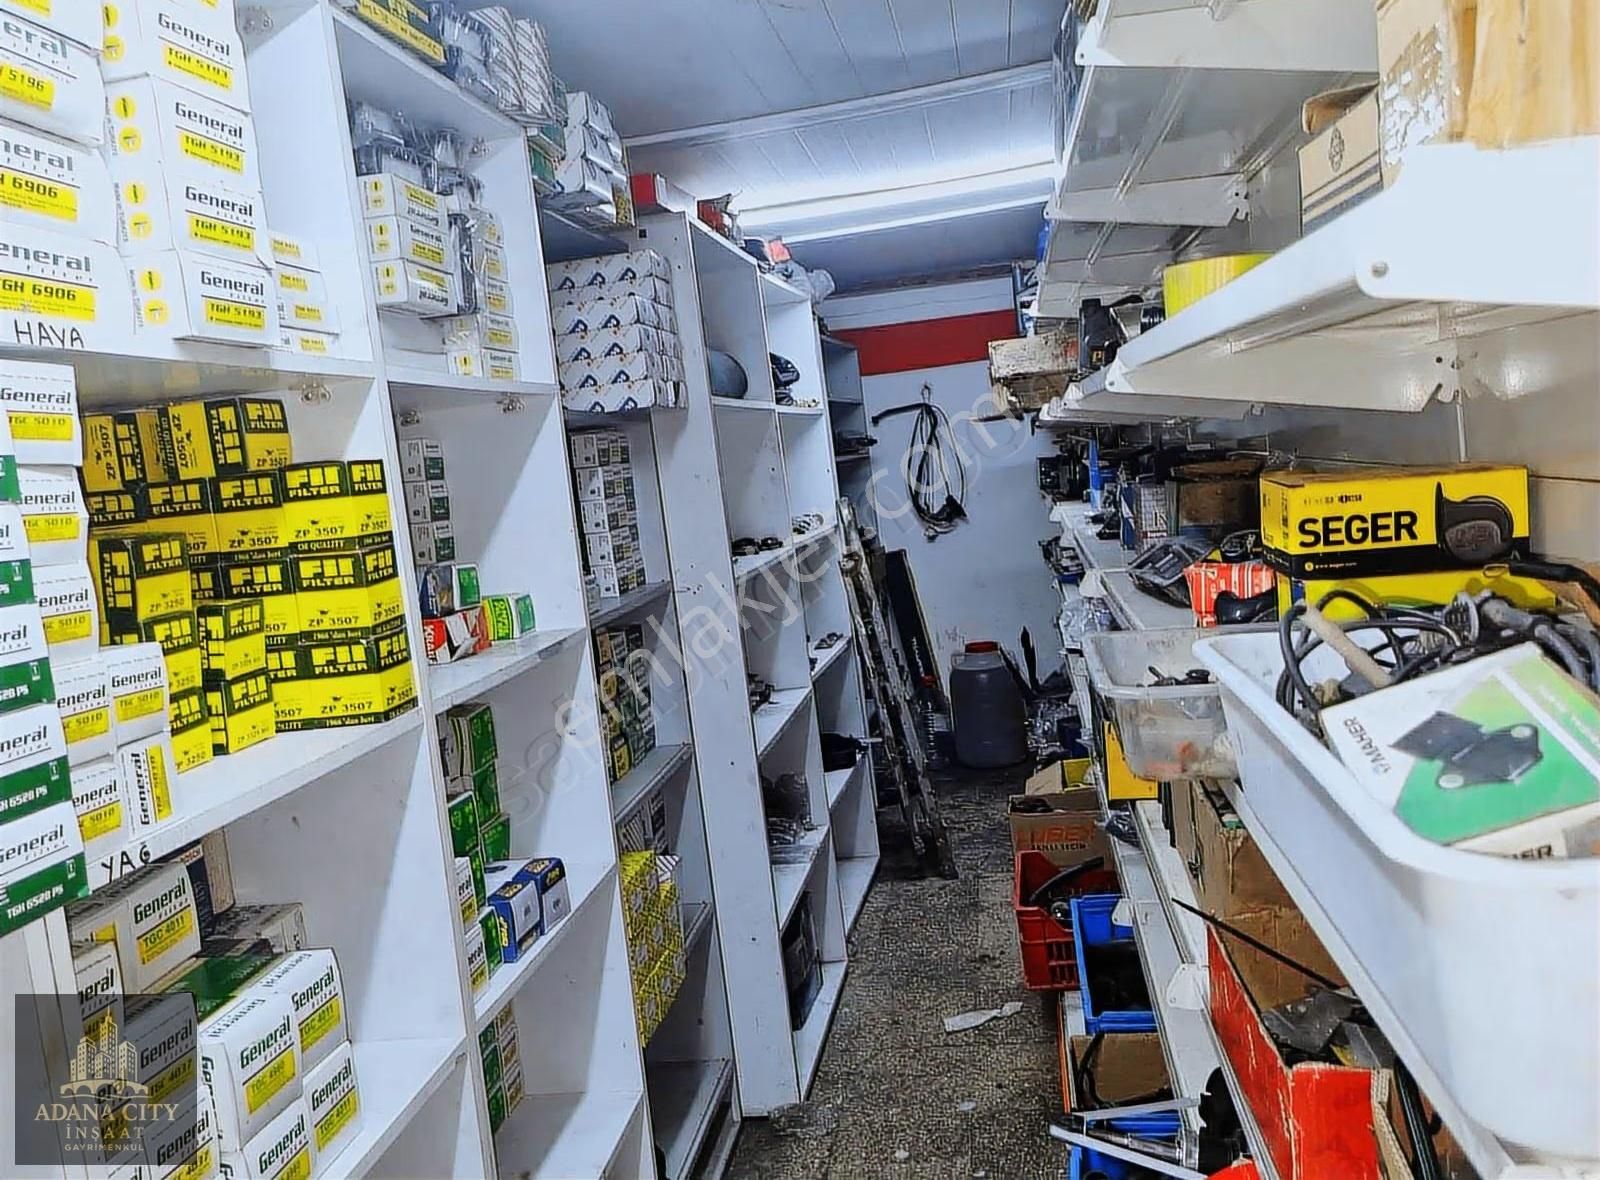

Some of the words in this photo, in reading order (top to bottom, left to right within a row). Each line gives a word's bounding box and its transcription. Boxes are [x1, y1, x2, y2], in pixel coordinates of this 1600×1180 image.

[158, 12, 231, 56] General
[175, 101, 243, 139] General
[12, 176, 58, 199] 6906
[185, 185, 253, 217] General
[32, 283, 77, 302] 6906
[201, 270, 264, 296] General
[14, 318, 85, 349] HAYA
[0, 386, 71, 404] General
[250, 420, 284, 429] FILTER
[289, 485, 341, 498] FILTER
[353, 482, 383, 491] FILTER
[152, 502, 202, 515] FILTER
[223, 497, 274, 508] FILTER
[1296, 510, 1418, 549] SEGER
[249, 535, 279, 548] 3507
[145, 559, 183, 571] FILTER
[367, 567, 393, 581] FILTER
[232, 583, 282, 595] FILTER
[301, 576, 355, 588] FILTER
[231, 622, 260, 636] FILTER
[314, 662, 368, 675] FILTER
[380, 651, 408, 667] FILTER
[111, 666, 163, 689] General
[234, 691, 269, 710] FILTER
[36, 784, 48, 799] PS
[131, 752, 150, 826] General
[134, 877, 187, 925] General
[142, 928, 164, 948] TGC
[164, 914, 186, 933] 4011
[141, 1018, 193, 1069] General
[240, 1014, 291, 1070] General
[311, 1057, 353, 1113] General
[157, 1110, 210, 1167] General
[259, 1113, 306, 1175] General
